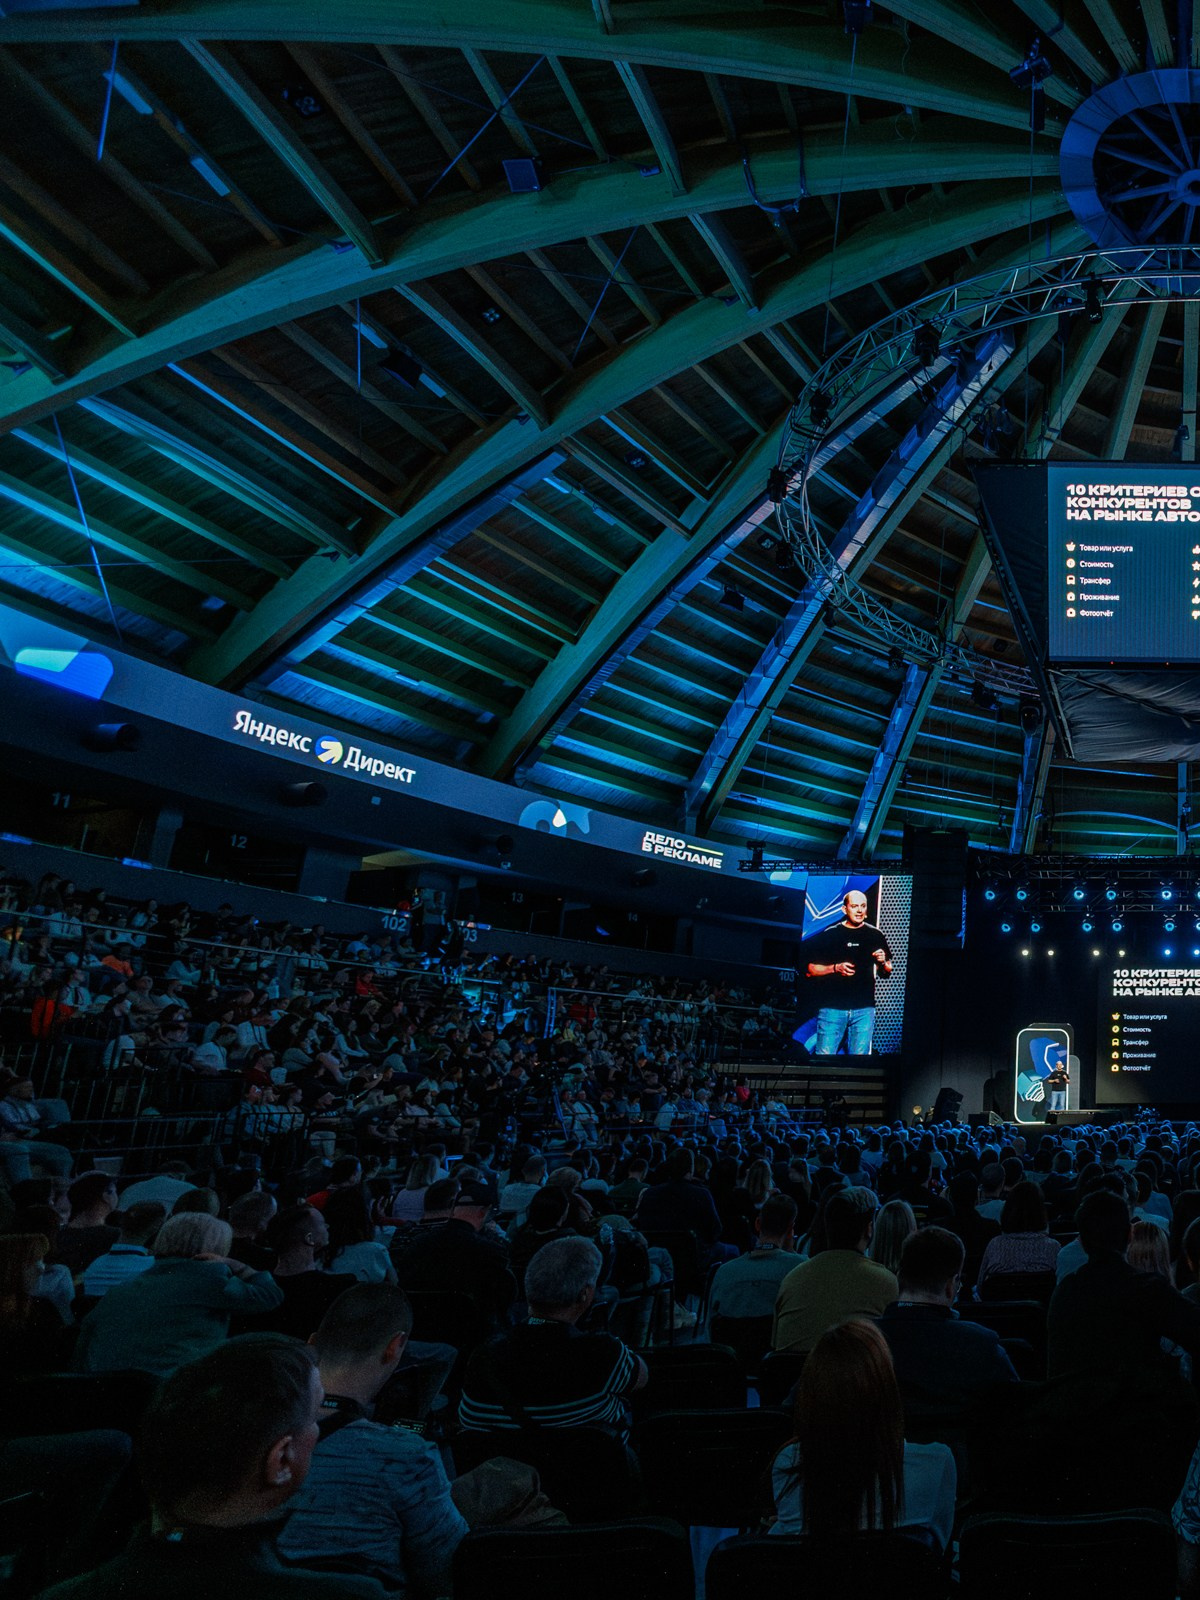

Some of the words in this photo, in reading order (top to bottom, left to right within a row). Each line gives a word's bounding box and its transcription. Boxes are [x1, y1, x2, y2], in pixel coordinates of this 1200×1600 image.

[1066, 484, 1086, 496] 10
[1088, 485, 1188, 497] КРИТЕРИЕВ
[1066, 496, 1192, 510] КОНКУРЕНТОВ
[1066, 509, 1092, 521] НА
[1093, 510, 1153, 522] РЫНКЕ
[1080, 544, 1099, 552] Товар
[1080, 560, 1114, 568] Стоимость
[1080, 577, 1111, 585] Трансфер
[1080, 593, 1120, 601] Проживание
[1080, 609, 1114, 617] Фотоотчёт
[233, 710, 312, 753] Яндекс
[343, 746, 416, 784] Директ
[52, 792, 71, 808] 11
[231, 833, 249, 850] 12
[643, 831, 686, 850] ДЕЛО
[641, 841, 653, 852] В
[654, 844, 723, 869] РЕКЛАМЕ
[511, 891, 524, 904] 13
[381, 914, 407, 932] 102
[627, 911, 640, 923] 14
[1113, 969, 1129, 978] 10
[1113, 988, 1133, 996] НА
[1135, 988, 1183, 996] РЫНКЕ
